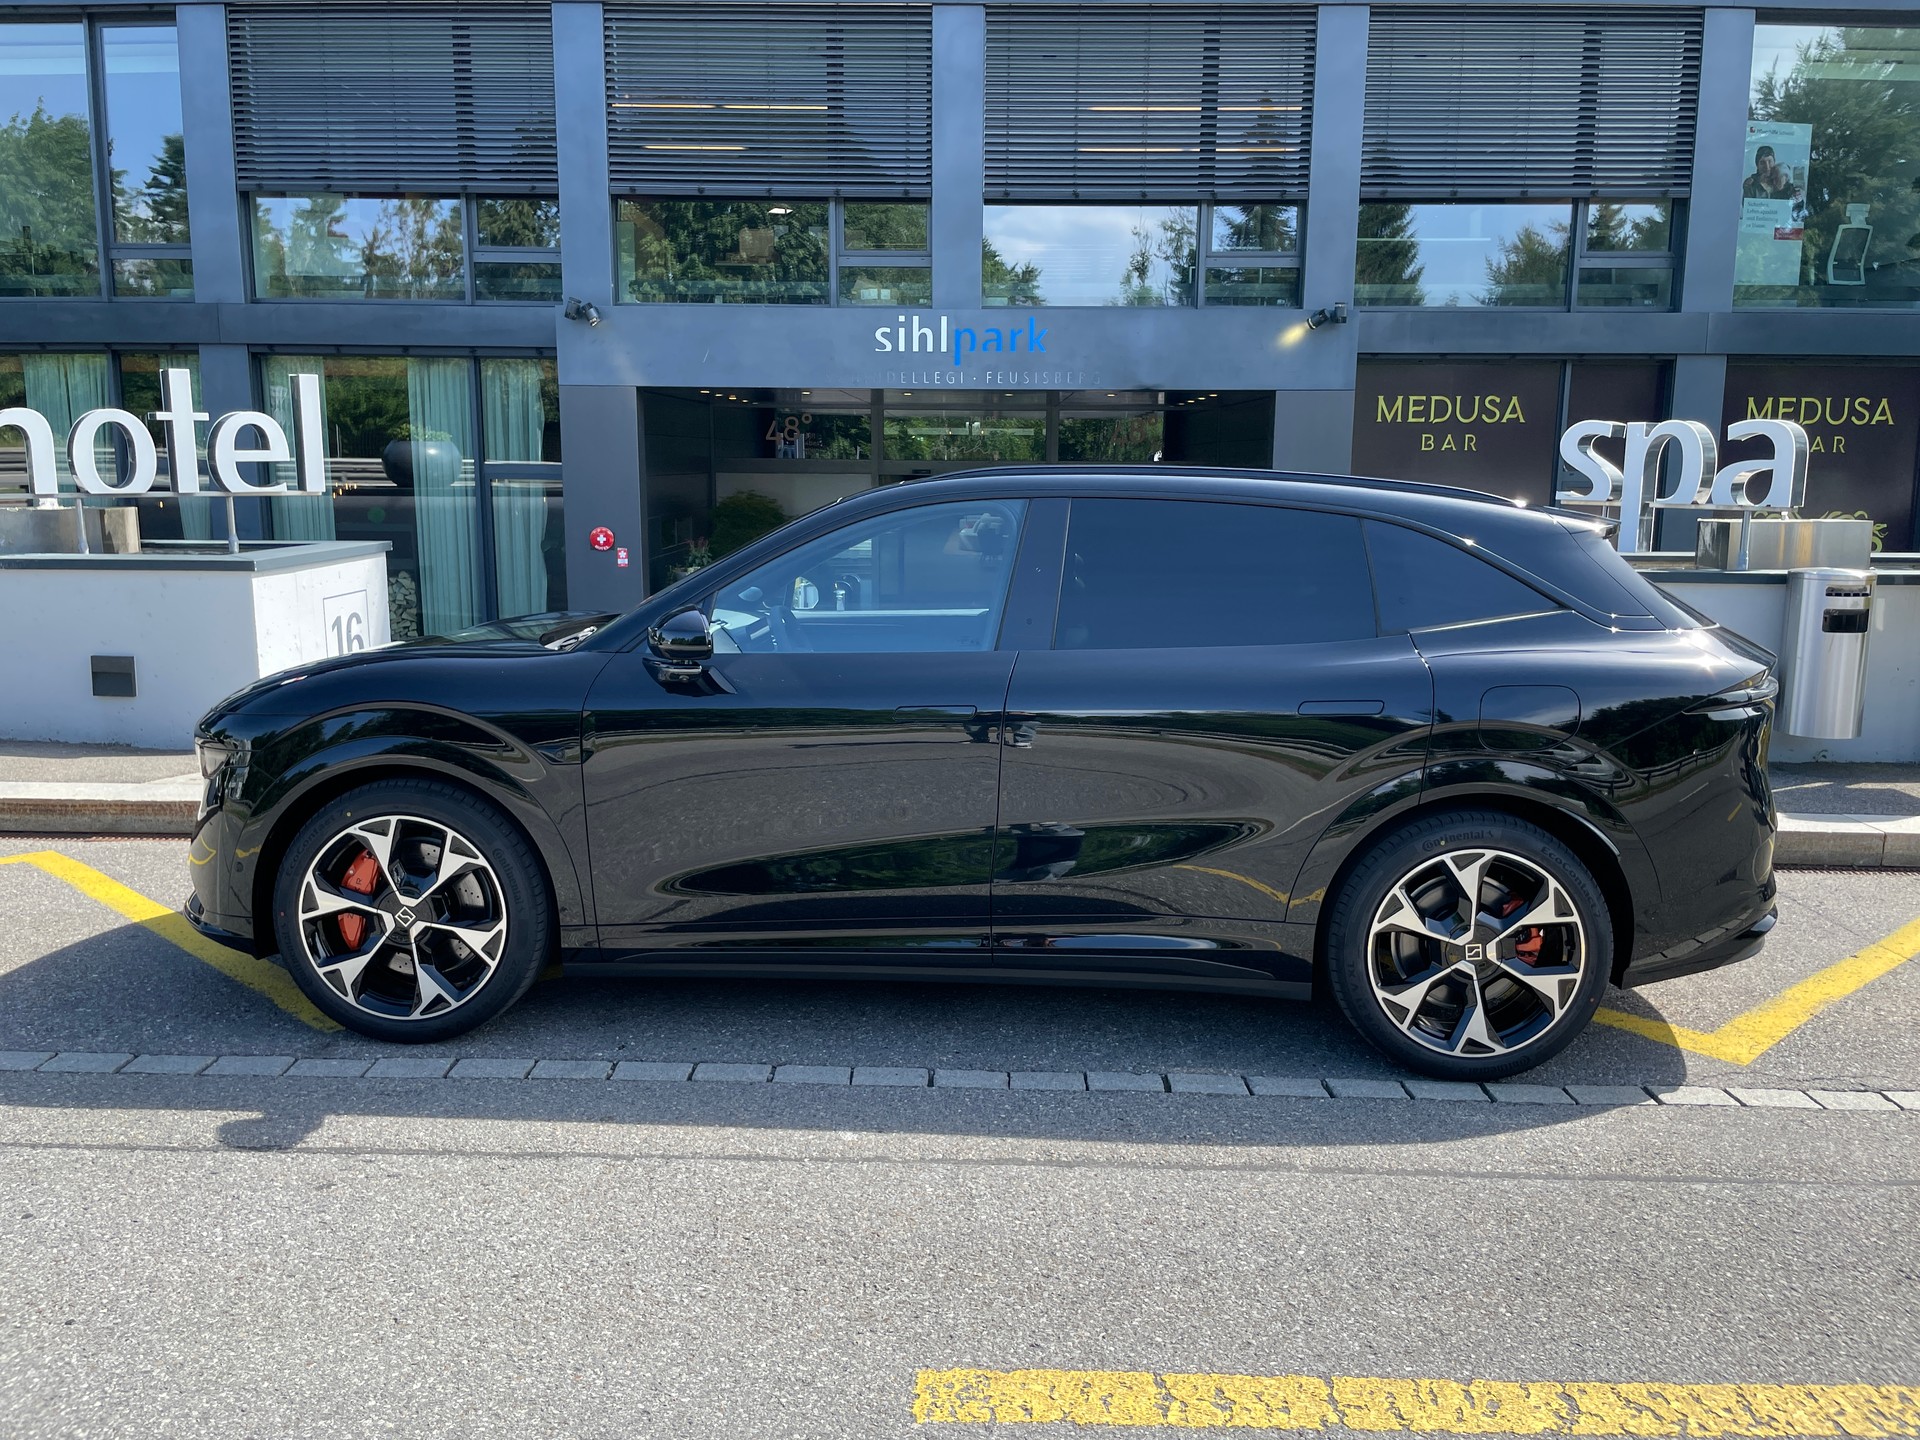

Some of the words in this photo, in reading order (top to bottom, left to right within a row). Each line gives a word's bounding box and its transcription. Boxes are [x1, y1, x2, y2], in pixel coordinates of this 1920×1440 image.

[874, 315, 1048, 366] sihlpark
[1376, 395, 1526, 424] MEDUSA
[1746, 396, 1895, 425] MEDUSA
[1421, 435, 1478, 452] BAR
[1810, 436, 1846, 453] AR
[1556, 419, 1811, 553] spa
[331, 612, 365, 656] 16
